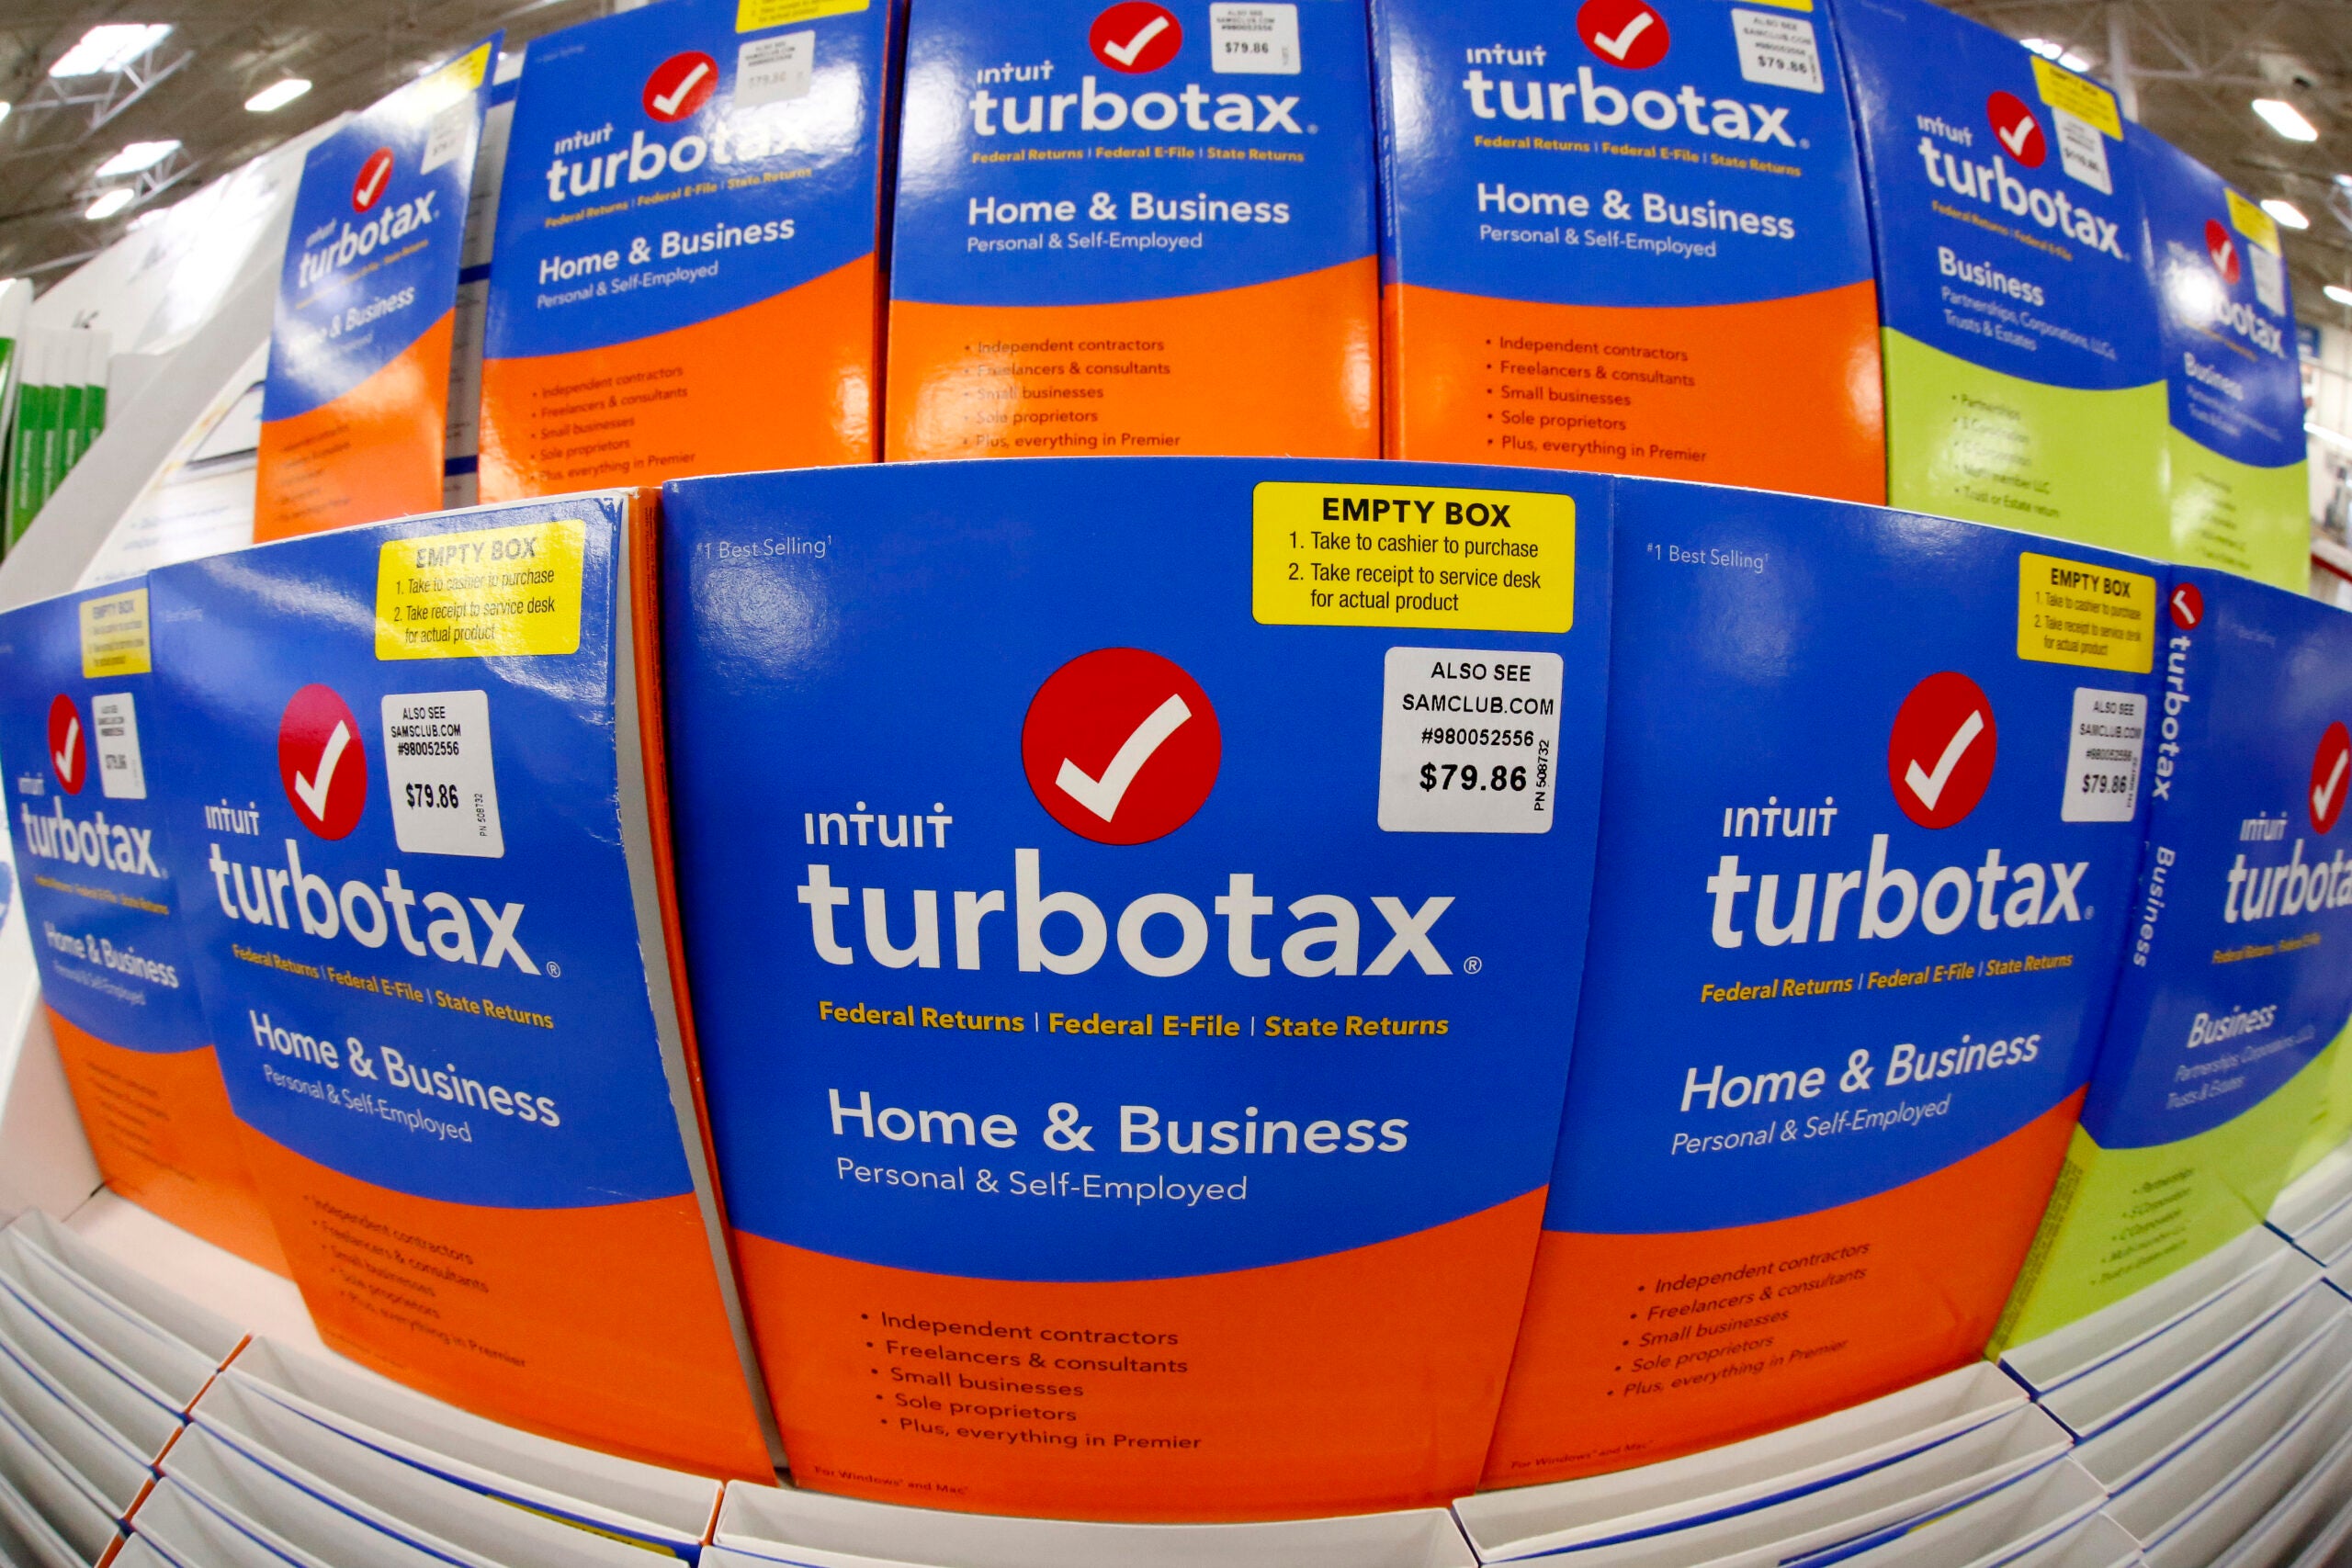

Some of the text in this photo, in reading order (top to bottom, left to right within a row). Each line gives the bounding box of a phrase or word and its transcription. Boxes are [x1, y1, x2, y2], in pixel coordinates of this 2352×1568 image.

[1225, 41, 1270, 55] $79.86
[1758, 55, 1808, 74] $79.86
[969, 75, 1303, 136] turbotax
[1463, 66, 1796, 148] turbotax
[968, 191, 1290, 226] Home & Business
[1477, 183, 1795, 240] Home & Business
[1918, 137, 2123, 261] turbotax
[299, 189, 437, 289] turbotax
[538, 218, 796, 285] Home & Business
[967, 231, 1203, 253] Personal & Self-Employed
[1480, 225, 1717, 259] Personal & Self-Employed
[1938, 245, 2045, 308] Business
[1499, 336, 1689, 363] Independent contractors
[1500, 360, 1695, 388] Freelancers & consultants
[1323, 498, 1511, 527] EMPTY BOX
[416, 537, 537, 569] EMPTY BOX
[719, 541, 758, 558] Best
[1290, 531, 1538, 558] 1. Take to cashier to purchase
[1647, 543, 1661, 560] #1
[1669, 545, 1705, 564] Best
[1289, 563, 1541, 588] 2. Take receipt to service desk
[2051, 569, 2131, 598] EMPTY BOX
[1311, 590, 1458, 613] for actual product
[405, 624, 495, 644] for actual product
[1431, 662, 1531, 682] ALSO SEE
[402, 706, 446, 719] ALSO SEE
[1402, 694, 1554, 715] SAMCLUB.COM
[2153, 636, 2191, 800] turbotax
[391, 724, 460, 738] SAMSCLUB.COM
[398, 741, 458, 756] #980052556
[1421, 728, 1534, 746] #980052556
[1419, 762, 1527, 792] $79.86
[1534, 739, 1549, 811] PN 508732
[2082, 774, 2127, 794] $79.86
[406, 782, 458, 809] $79.86
[206, 799, 259, 836] intuit
[474, 793, 487, 837] PN 508732
[805, 801, 953, 849] intuit
[1723, 795, 1838, 838] intuit
[22, 795, 161, 878] turbotax
[1706, 834, 2089, 949] turbotax
[2224, 839, 2352, 923] turbota
[209, 839, 541, 976] turbotax
[797, 848, 1455, 977] turbotax
[2132, 846, 2177, 968] Business
[44, 920, 86, 960] Home
[88, 934, 100, 964] &
[101, 938, 179, 988] Business
[232, 944, 554, 1030] Federal Returns Federal E-File State Returns
[1701, 953, 2073, 1003] Federal Returns Federal E-File State Returns
[819, 1001, 1449, 1036] Federal Returns Federal E-File State Returns
[2187, 1004, 2278, 1048] Business
[250, 1010, 560, 1127] Home & Business
[1680, 1033, 2041, 1112] Home & Business
[264, 1065, 472, 1143] Personal & Self-Employed
[829, 1089, 1409, 1154] Home & Business
[1671, 1094, 1951, 1156] Personal & Self-Employed
[837, 1157, 1248, 1207] Personal & Self-Employed
[1655, 1242, 1871, 1294] Independent contractors
[1647, 1268, 1868, 1322] Freelancers & consultants
[881, 1312, 1179, 1346] Independent contractors
[1638, 1310, 1790, 1348] Small businesses
[886, 1340, 1188, 1373] Freelancers & consultants
[1631, 1337, 1774, 1373] Sole proprietors
[890, 1368, 1084, 1396] Small businesses
[895, 1393, 1077, 1421] Sole proprietors
[900, 1417, 1202, 1449] Plus, everything in Premier
